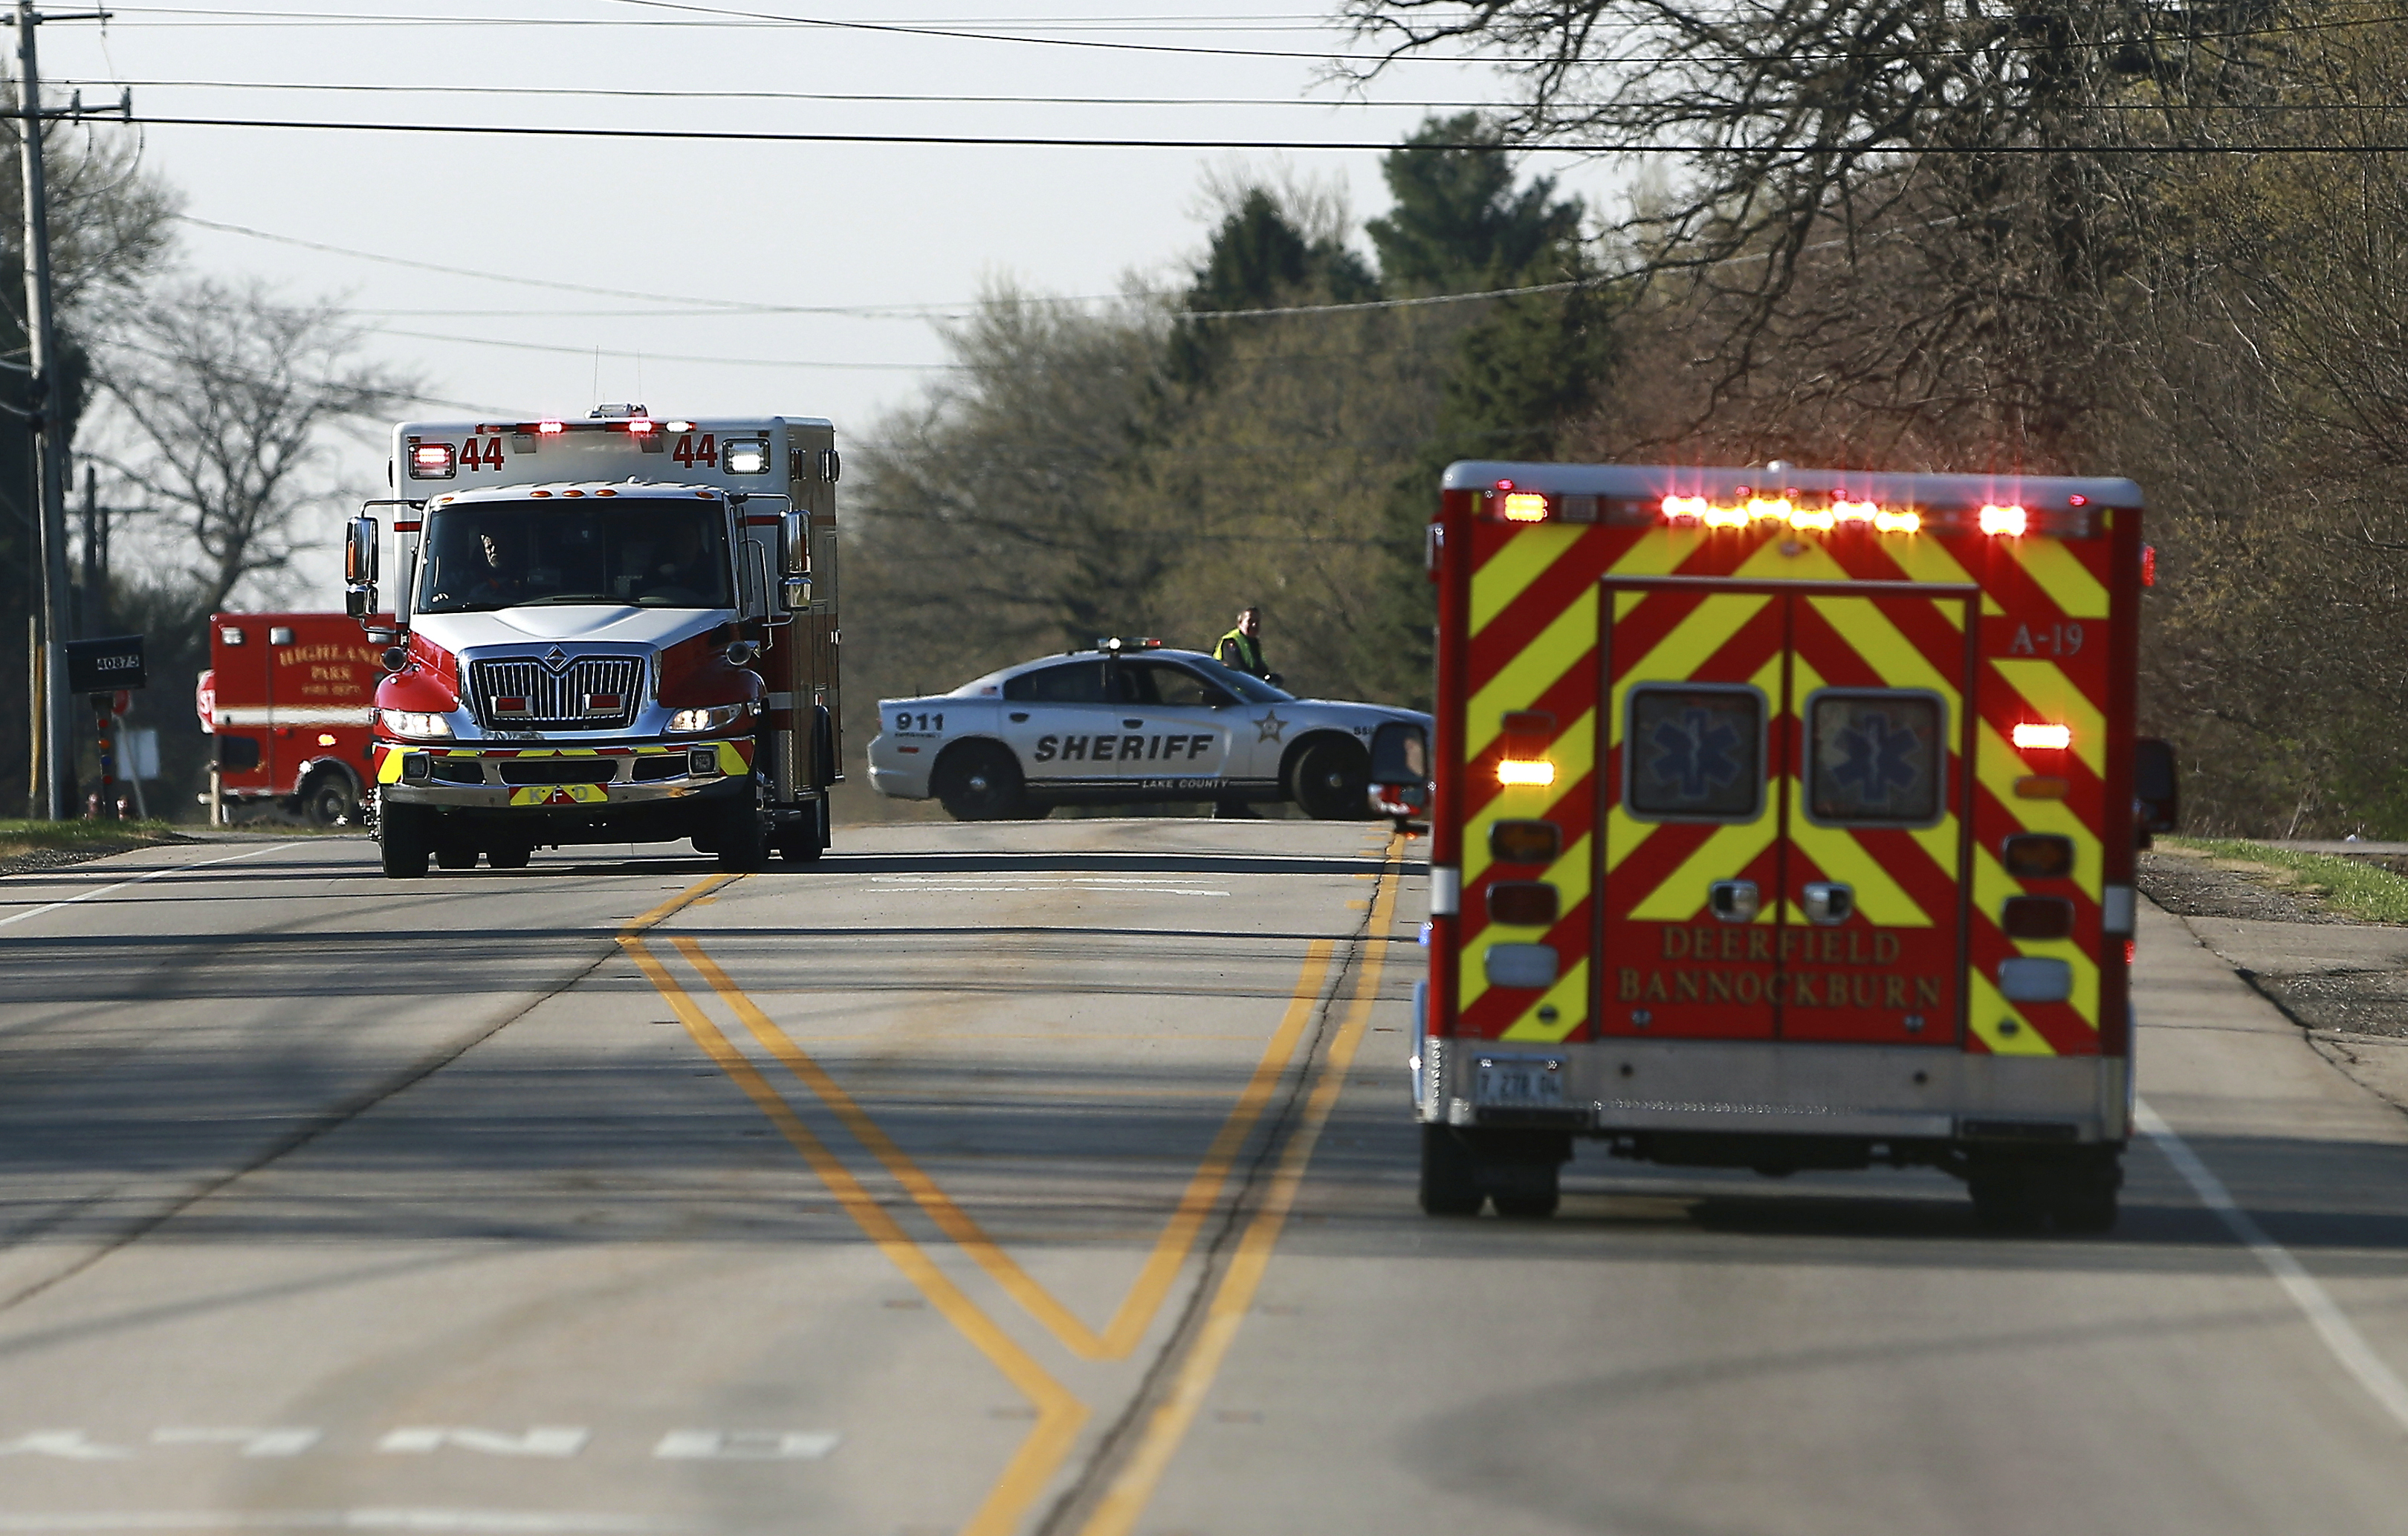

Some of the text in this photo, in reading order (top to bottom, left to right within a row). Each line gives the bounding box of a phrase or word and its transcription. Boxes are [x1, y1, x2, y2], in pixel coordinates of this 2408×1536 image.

[459, 437, 505, 472] 44
[672, 434, 718, 469] 44
[2010, 623, 2083, 656] A-19
[896, 712, 943, 730] 911
[1035, 734, 1214, 762] SHERIFF
[1143, 778, 1229, 788] LAKE COUNTY
[1663, 925, 1902, 965] DEERFIELD
[1617, 968, 1941, 1008] BANNOCKBURN
